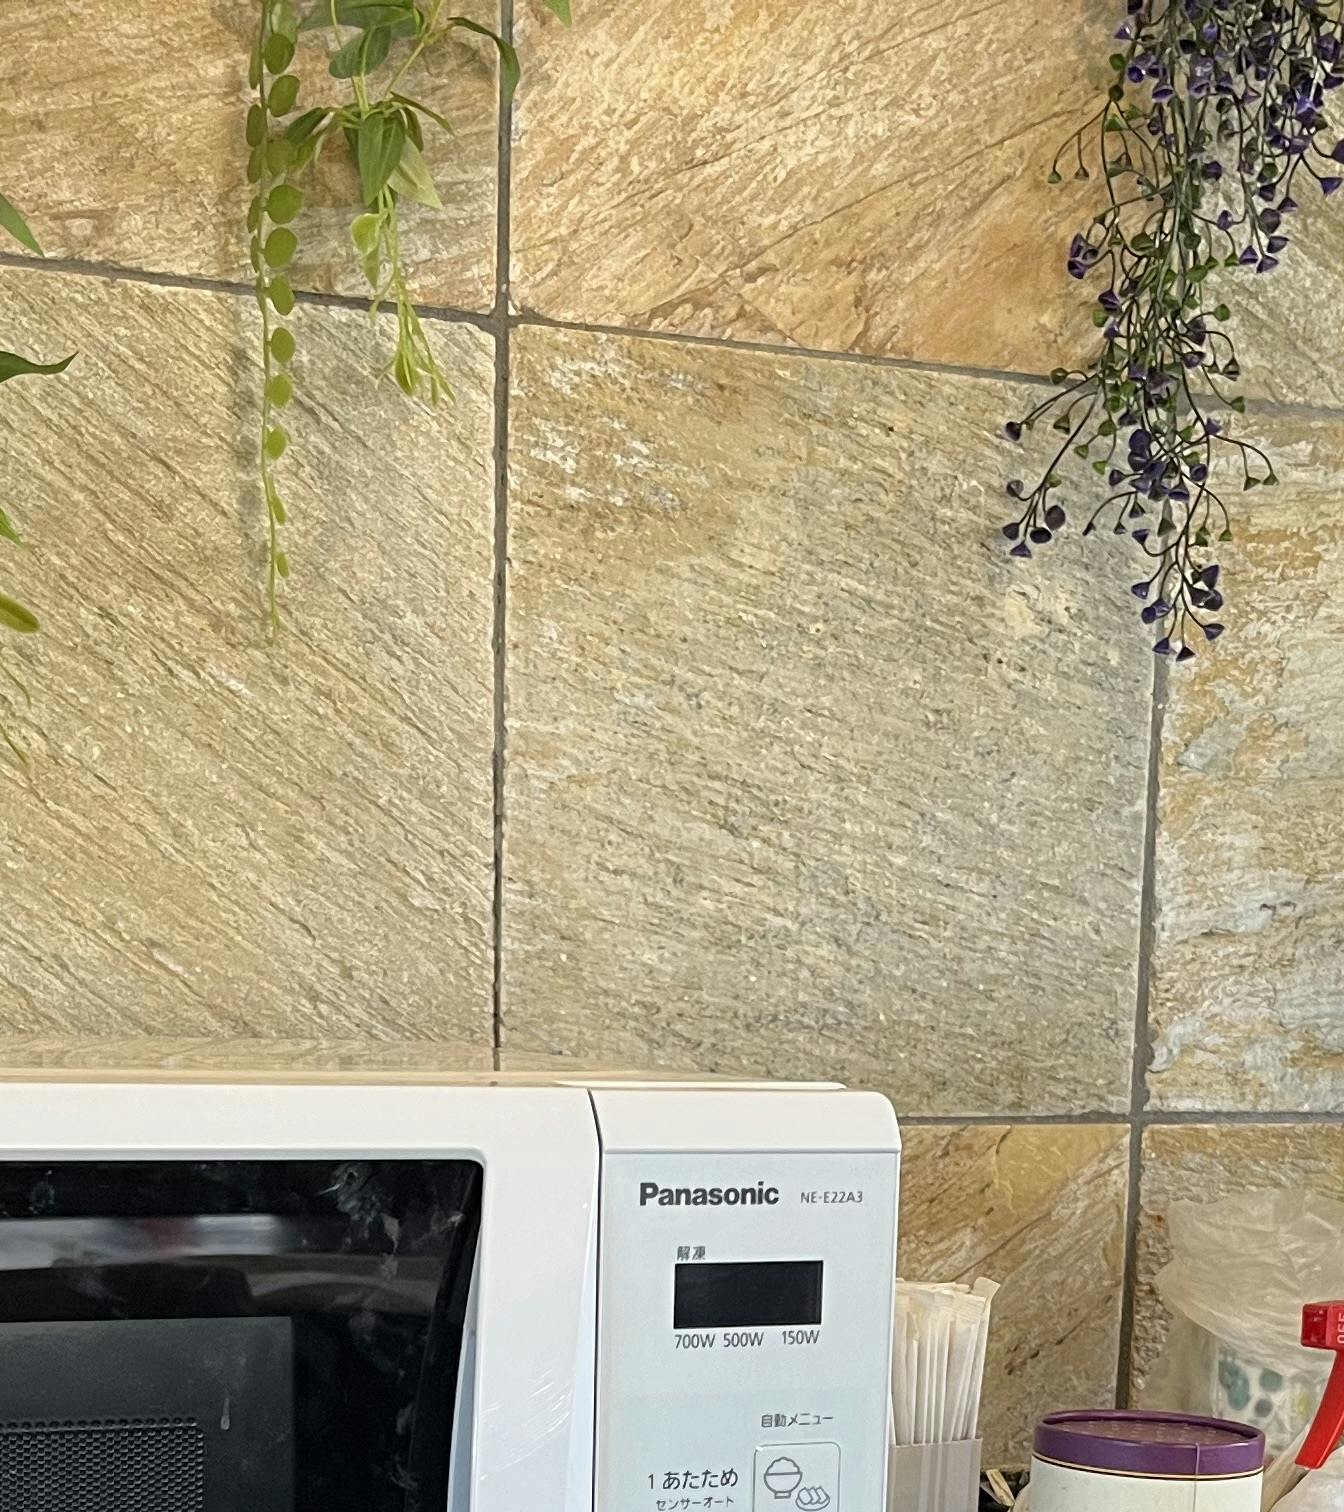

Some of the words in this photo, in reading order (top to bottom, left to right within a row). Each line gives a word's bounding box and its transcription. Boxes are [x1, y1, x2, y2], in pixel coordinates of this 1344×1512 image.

[639, 1181, 780, 1206] Panasonic
[800, 1190, 863, 1204] NE-E22A3
[676, 1246, 706, 1261] 解凍
[674, 1333, 716, 1350] 700W
[723, 1331, 765, 1348] 500W
[782, 1329, 820, 1346] 150W
[761, 1413, 834, 1428] 自動メニュー
[662, 1468, 739, 1490] あたため
[656, 1495, 735, 1511] センサーオート
